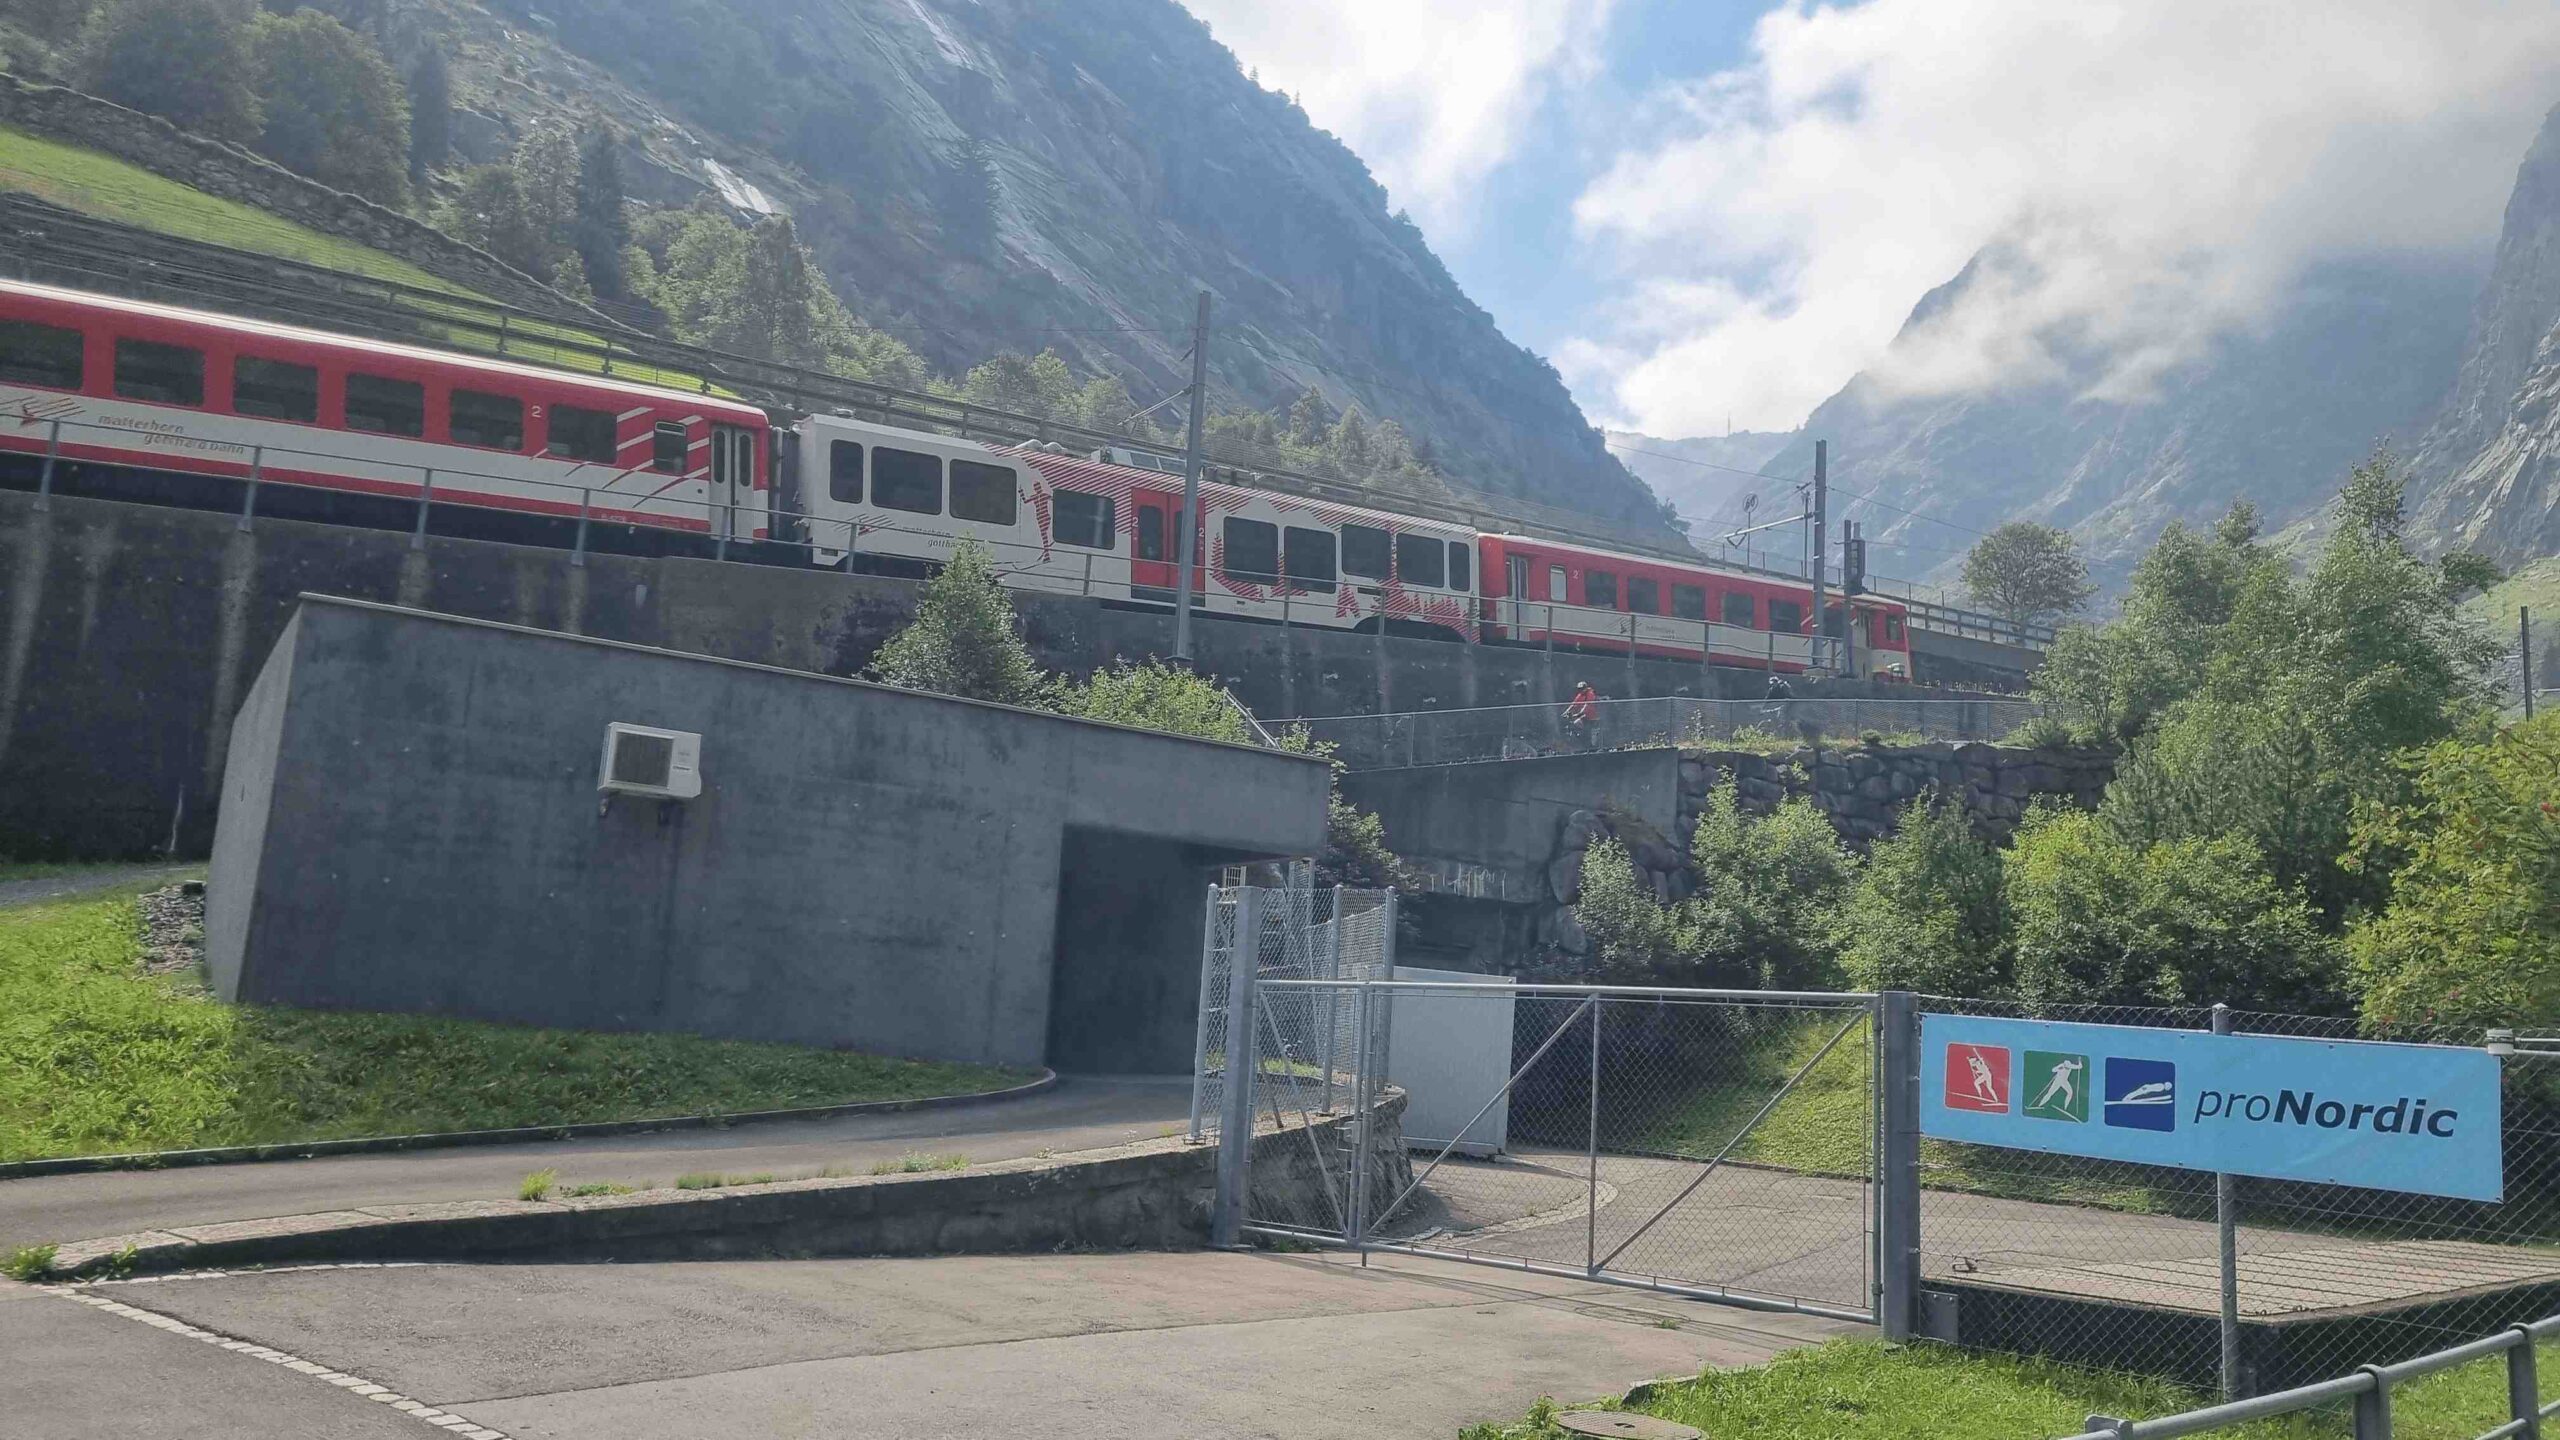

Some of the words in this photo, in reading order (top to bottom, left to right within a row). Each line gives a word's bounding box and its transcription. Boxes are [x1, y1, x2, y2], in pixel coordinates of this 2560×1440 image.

[531, 405, 542, 418] 2
[98, 414, 184, 434] matterhorn
[1132, 516, 1139, 528] 2
[1198, 527, 1205, 538] 2
[1573, 569, 1579, 580] 2
[2194, 1089, 2458, 1138] proNordic
